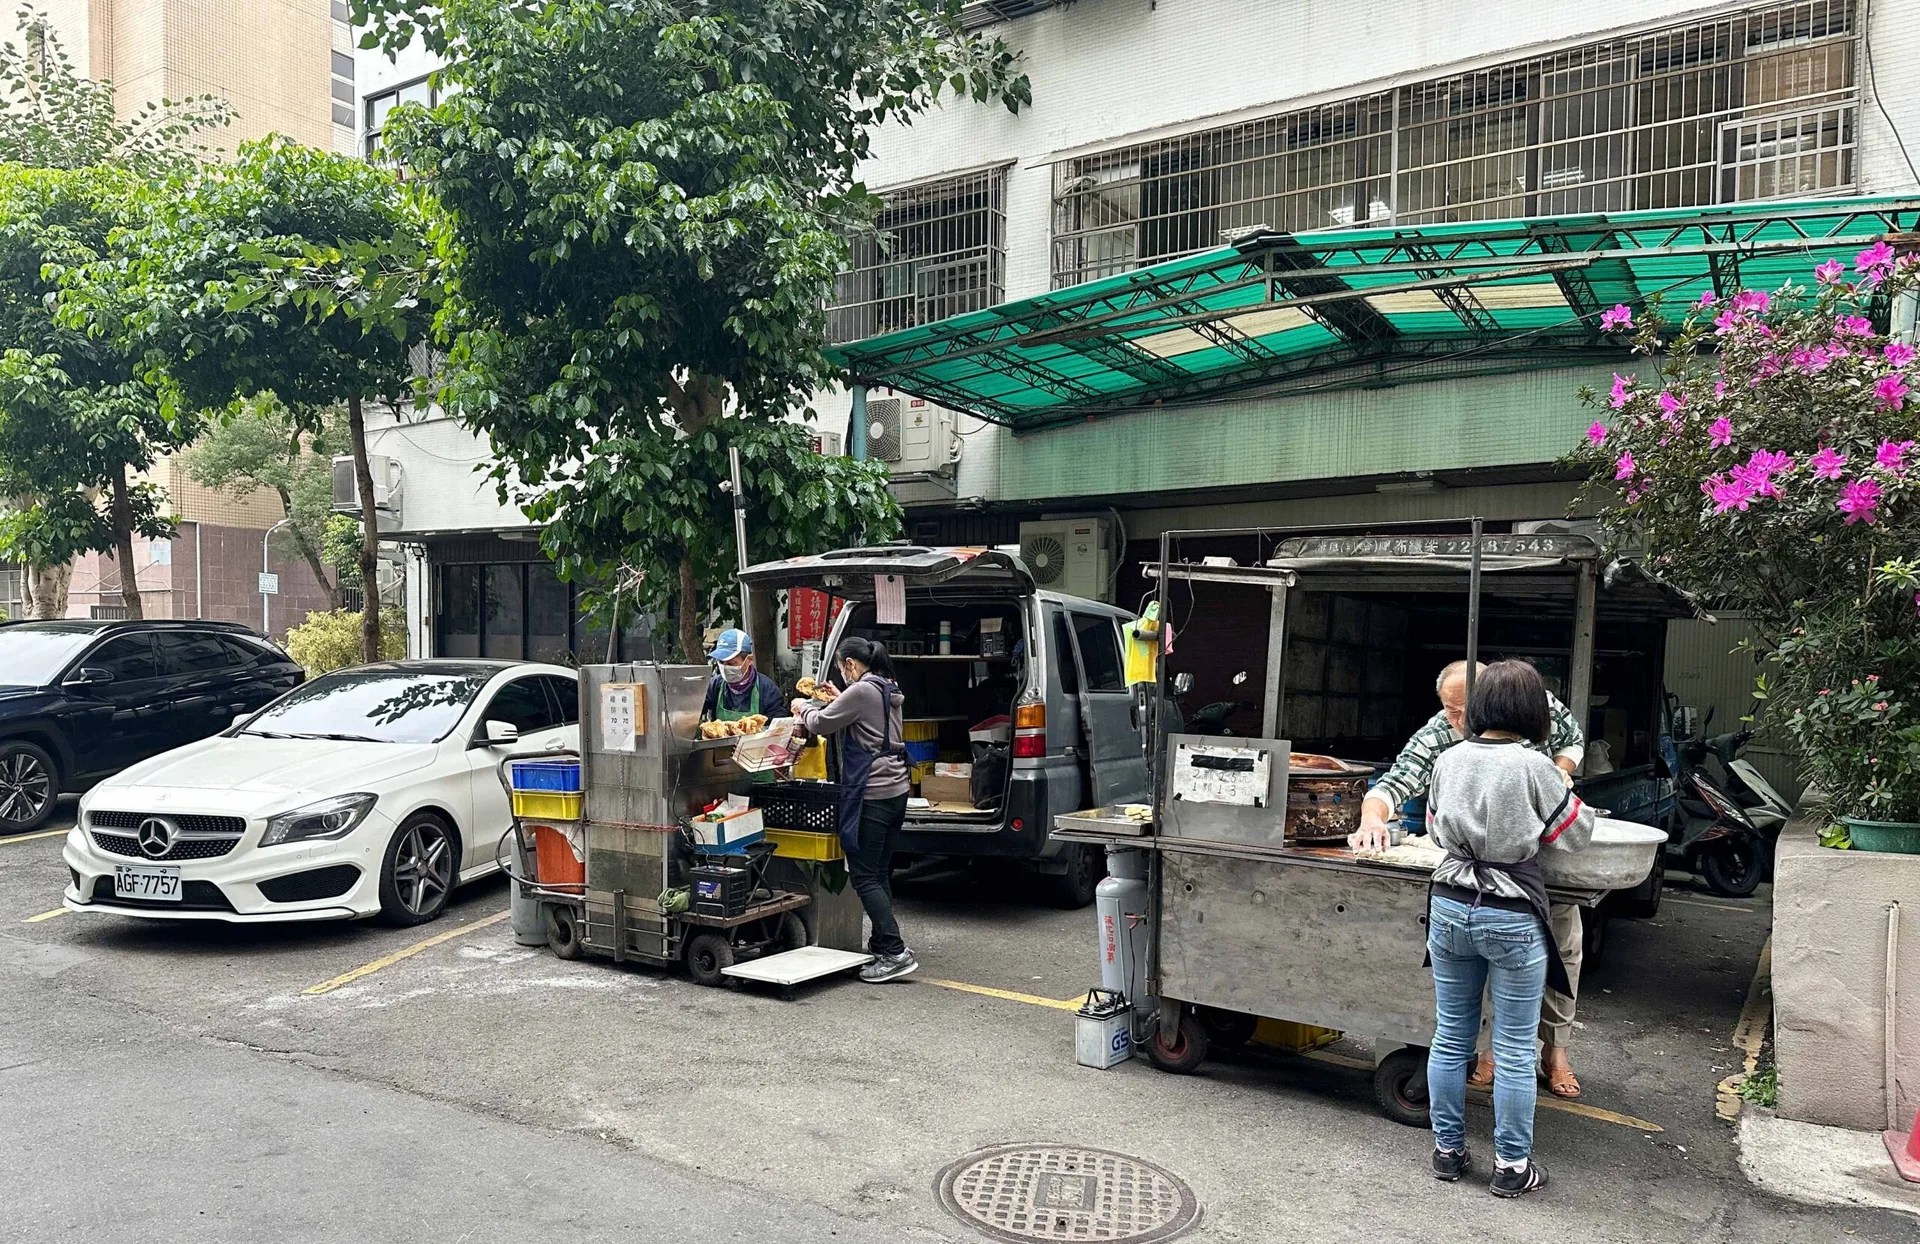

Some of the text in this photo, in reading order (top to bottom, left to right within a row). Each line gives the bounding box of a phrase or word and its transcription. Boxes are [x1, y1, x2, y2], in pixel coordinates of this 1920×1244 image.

[1446, 538, 1554, 552] 2287543
[809, 590, 820, 639] 請勿停
[1112, 1030, 1129, 1051] GS
